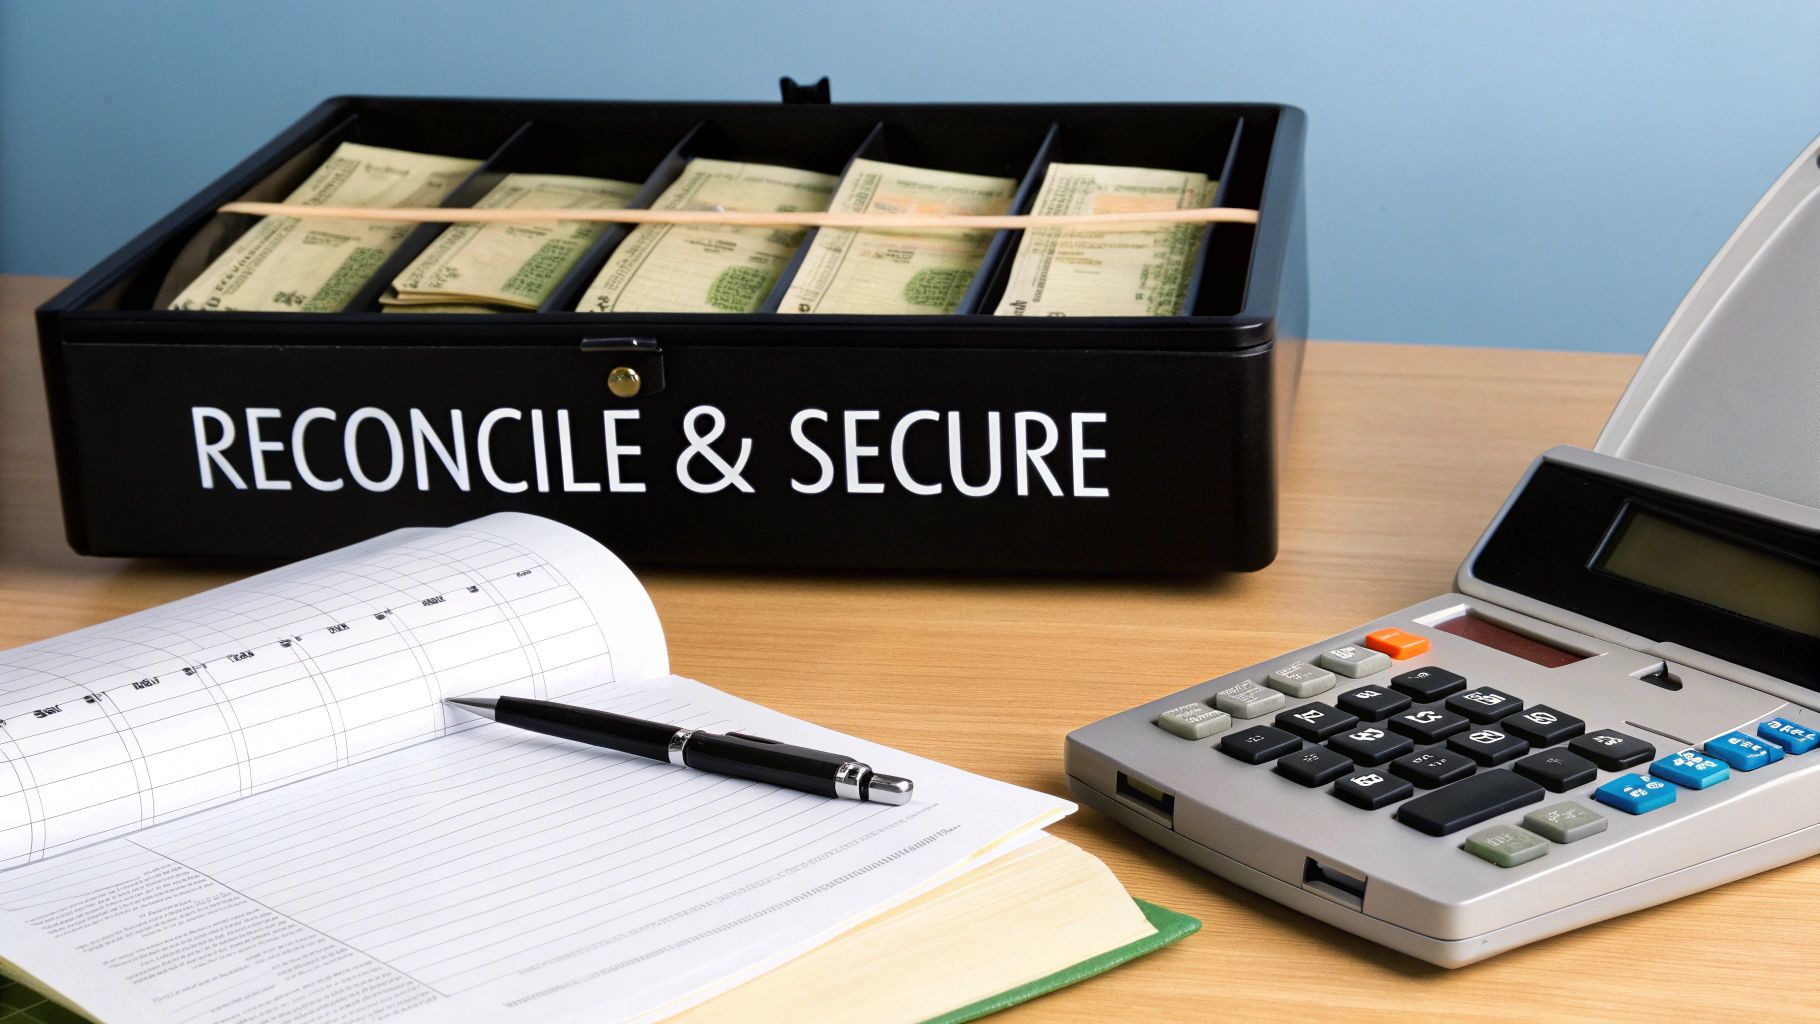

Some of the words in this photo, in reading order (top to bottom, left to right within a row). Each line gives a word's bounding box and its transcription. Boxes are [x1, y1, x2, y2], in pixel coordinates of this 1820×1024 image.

[191, 406, 647, 494] RECONCILE
[676, 404, 756, 494] &
[790, 408, 1110, 498] SECURE
